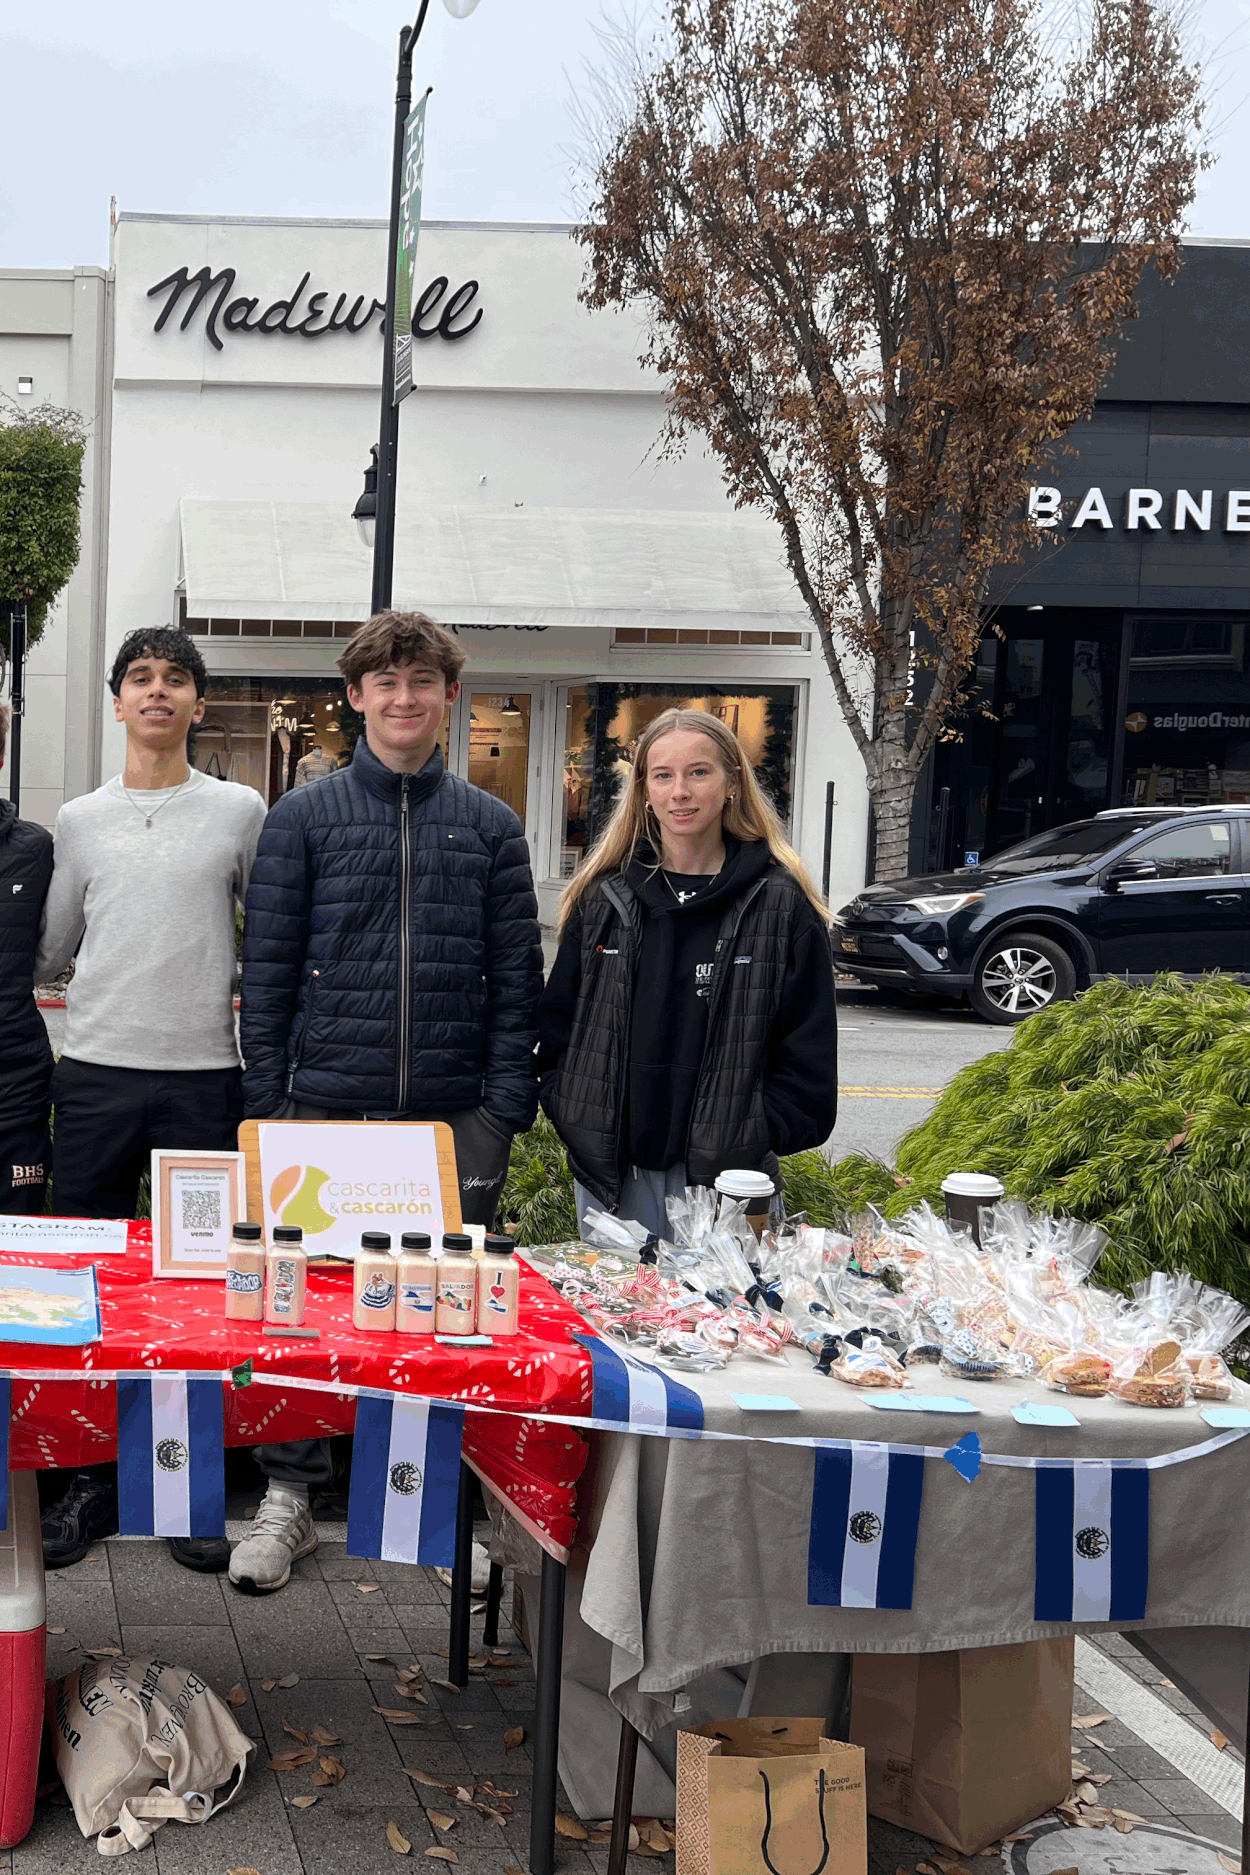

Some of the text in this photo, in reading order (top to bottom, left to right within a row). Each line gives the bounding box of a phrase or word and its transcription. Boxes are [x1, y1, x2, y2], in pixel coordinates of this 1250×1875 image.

[400, 115, 420, 250] Hope
[146, 266, 484, 350] Madewll
[1027, 486, 1250, 532] BARNE
[12, 1163, 44, 1179] BHS
[327, 1177, 432, 1197] cascarita
[340, 1198, 433, 1214] cascarón
[815, 1786, 837, 1794] SUFF
[831, 1777, 850, 1785] GOOD
